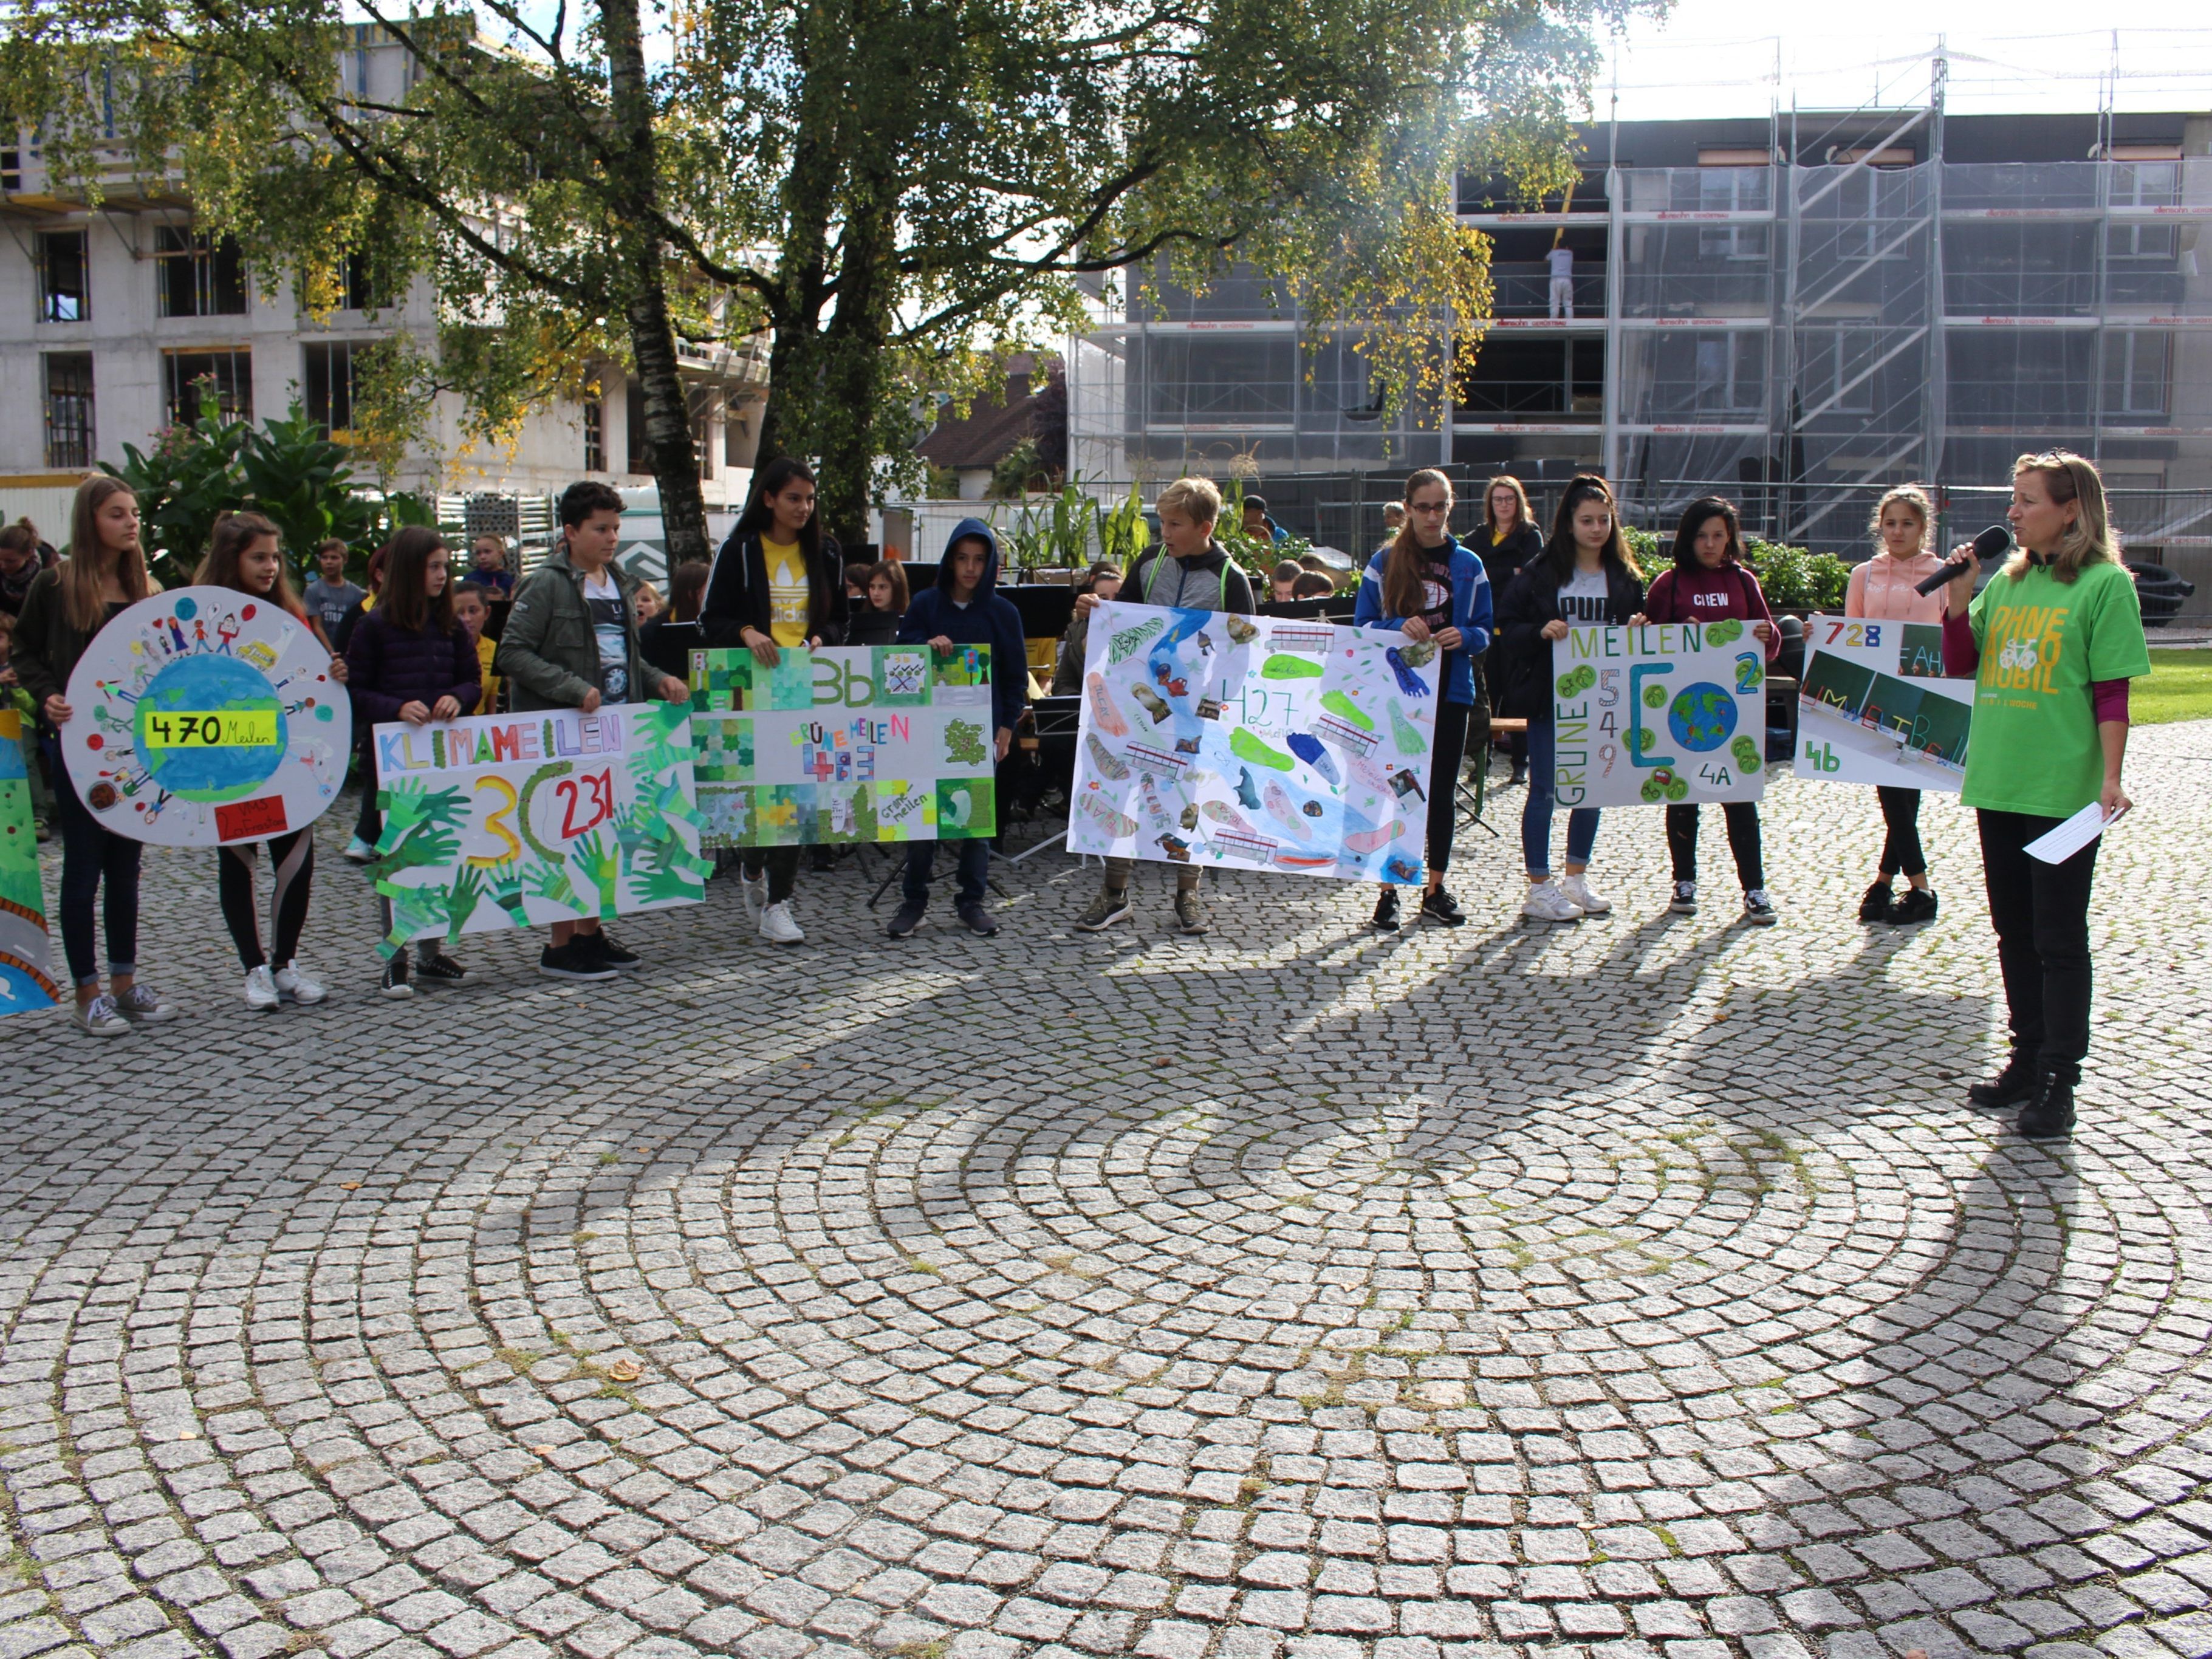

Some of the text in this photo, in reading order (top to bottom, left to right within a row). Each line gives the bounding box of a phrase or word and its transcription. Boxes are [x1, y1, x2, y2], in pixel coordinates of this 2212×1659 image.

[770, 607, 808, 622] dida
[1561, 596, 1609, 621] PUM
[1693, 593, 1728, 606] CREW
[1825, 621, 1881, 648] 728
[1989, 605, 2069, 641] OHNE
[1570, 624, 1701, 658] MEILEN
[810, 657, 875, 708] 3b
[1222, 679, 1299, 727] 427
[152, 716, 270, 745] 470 Meilen
[379, 714, 621, 773] KLIMAMEILEN
[789, 713, 909, 751] GRÜNE MEILEN
[803, 743, 875, 782] 483
[1555, 702, 1588, 806] GRÜNE
[1805, 741, 1840, 772] 4b
[1699, 763, 1731, 785] 4A
[555, 767, 614, 840] 231
